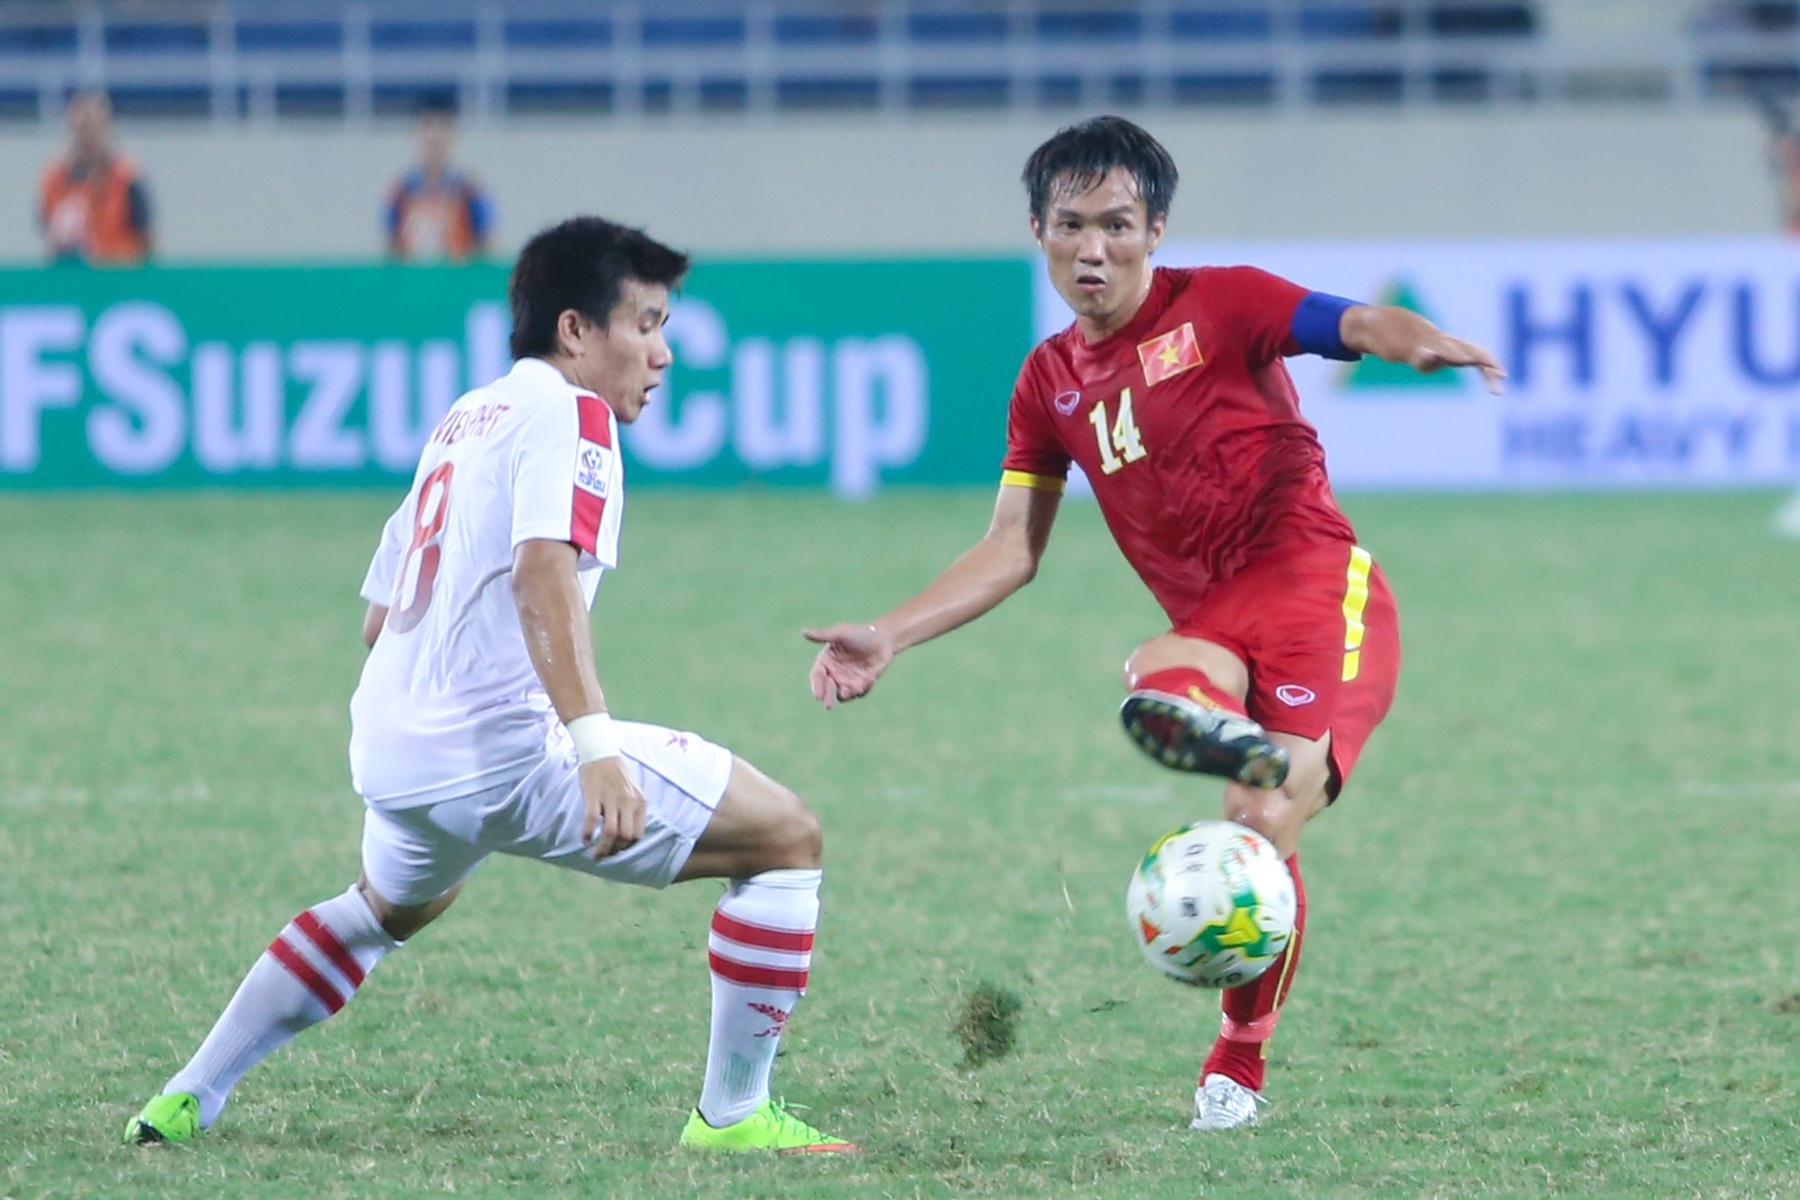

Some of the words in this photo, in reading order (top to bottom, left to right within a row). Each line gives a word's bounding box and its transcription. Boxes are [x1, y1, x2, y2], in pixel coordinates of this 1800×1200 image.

[622, 297, 931, 500] Cup
[1504, 280, 1800, 388] HYU
[1088, 387, 1147, 475] 14
[387, 461, 454, 634] 8
